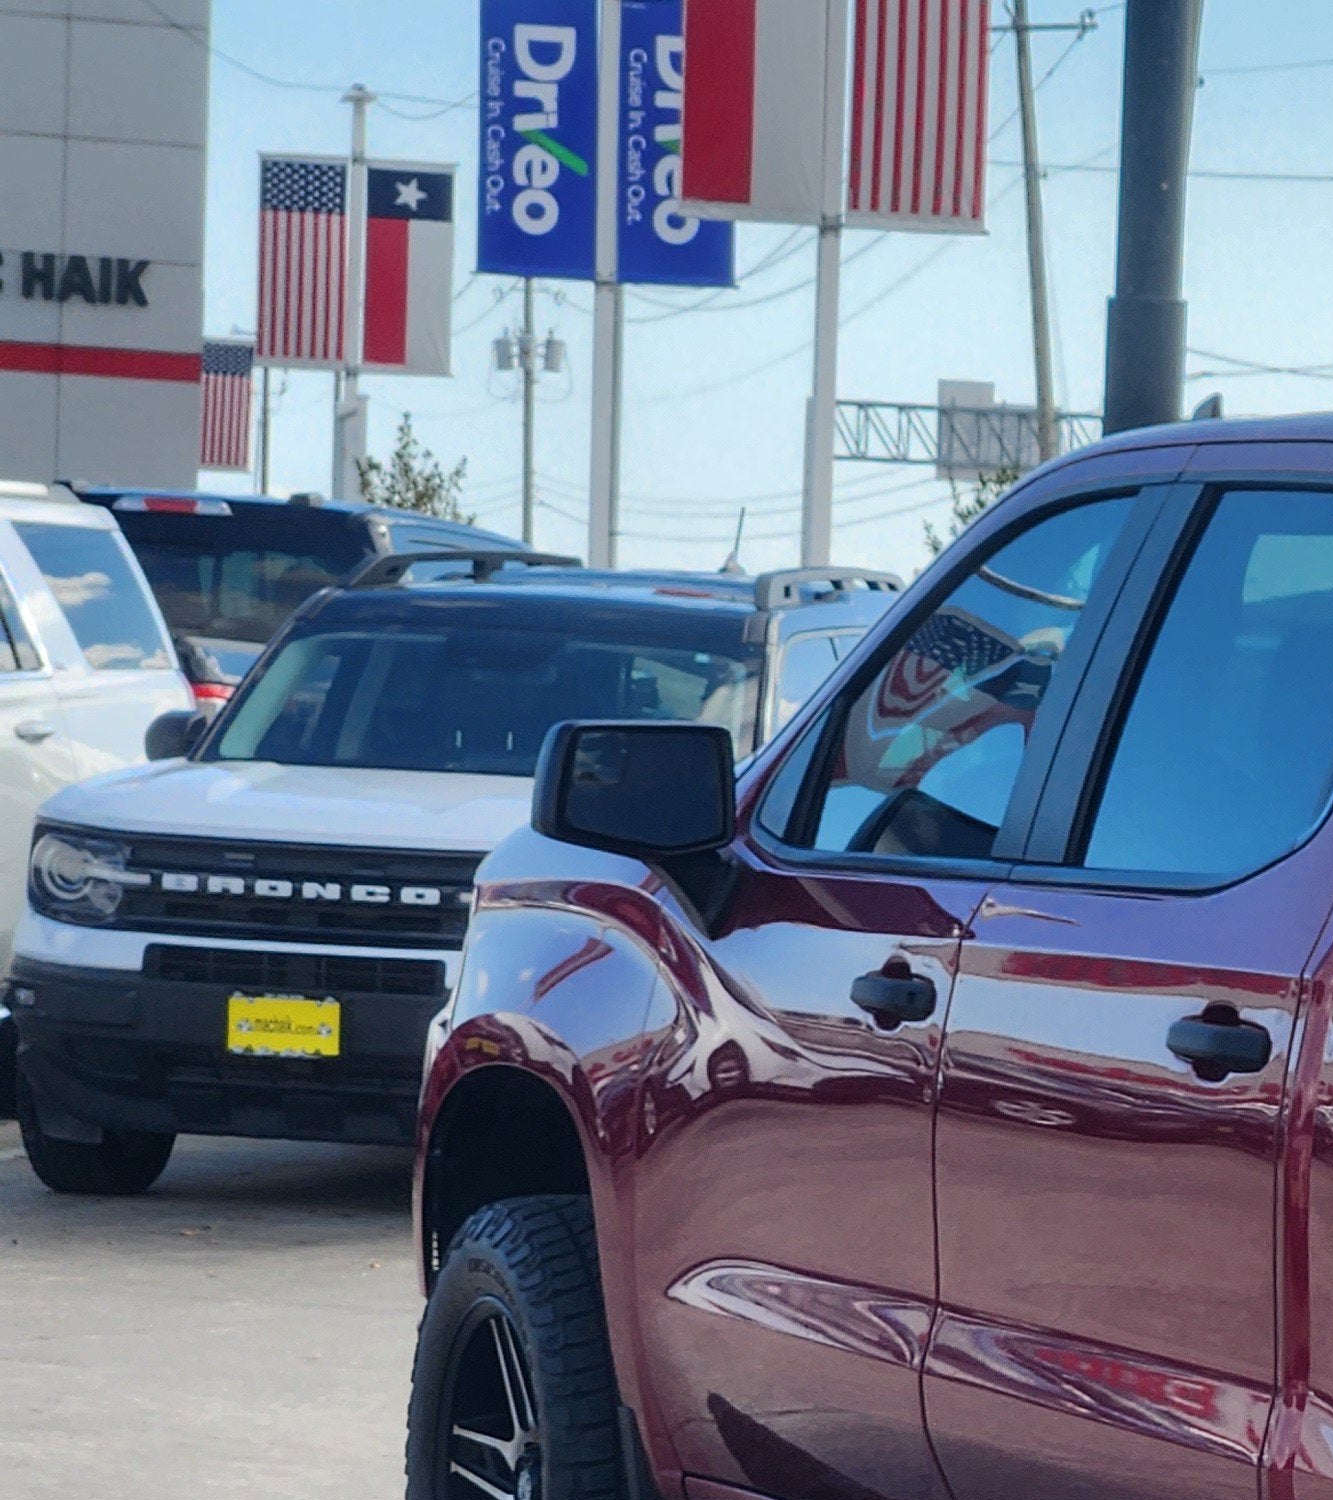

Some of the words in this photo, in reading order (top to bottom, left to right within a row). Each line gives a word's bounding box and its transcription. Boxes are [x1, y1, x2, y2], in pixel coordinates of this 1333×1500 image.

[487, 37, 506, 97] Cruise
[628, 48, 648, 107] Cruise
[487, 101, 505, 119] In
[512, 23, 588, 235] Driveo
[628, 110, 646, 129] In
[486, 124, 505, 171] Cash
[627, 134, 646, 181] Cash
[21, 252, 150, 307] HAIK
[161, 873, 441, 906] BRONCO
